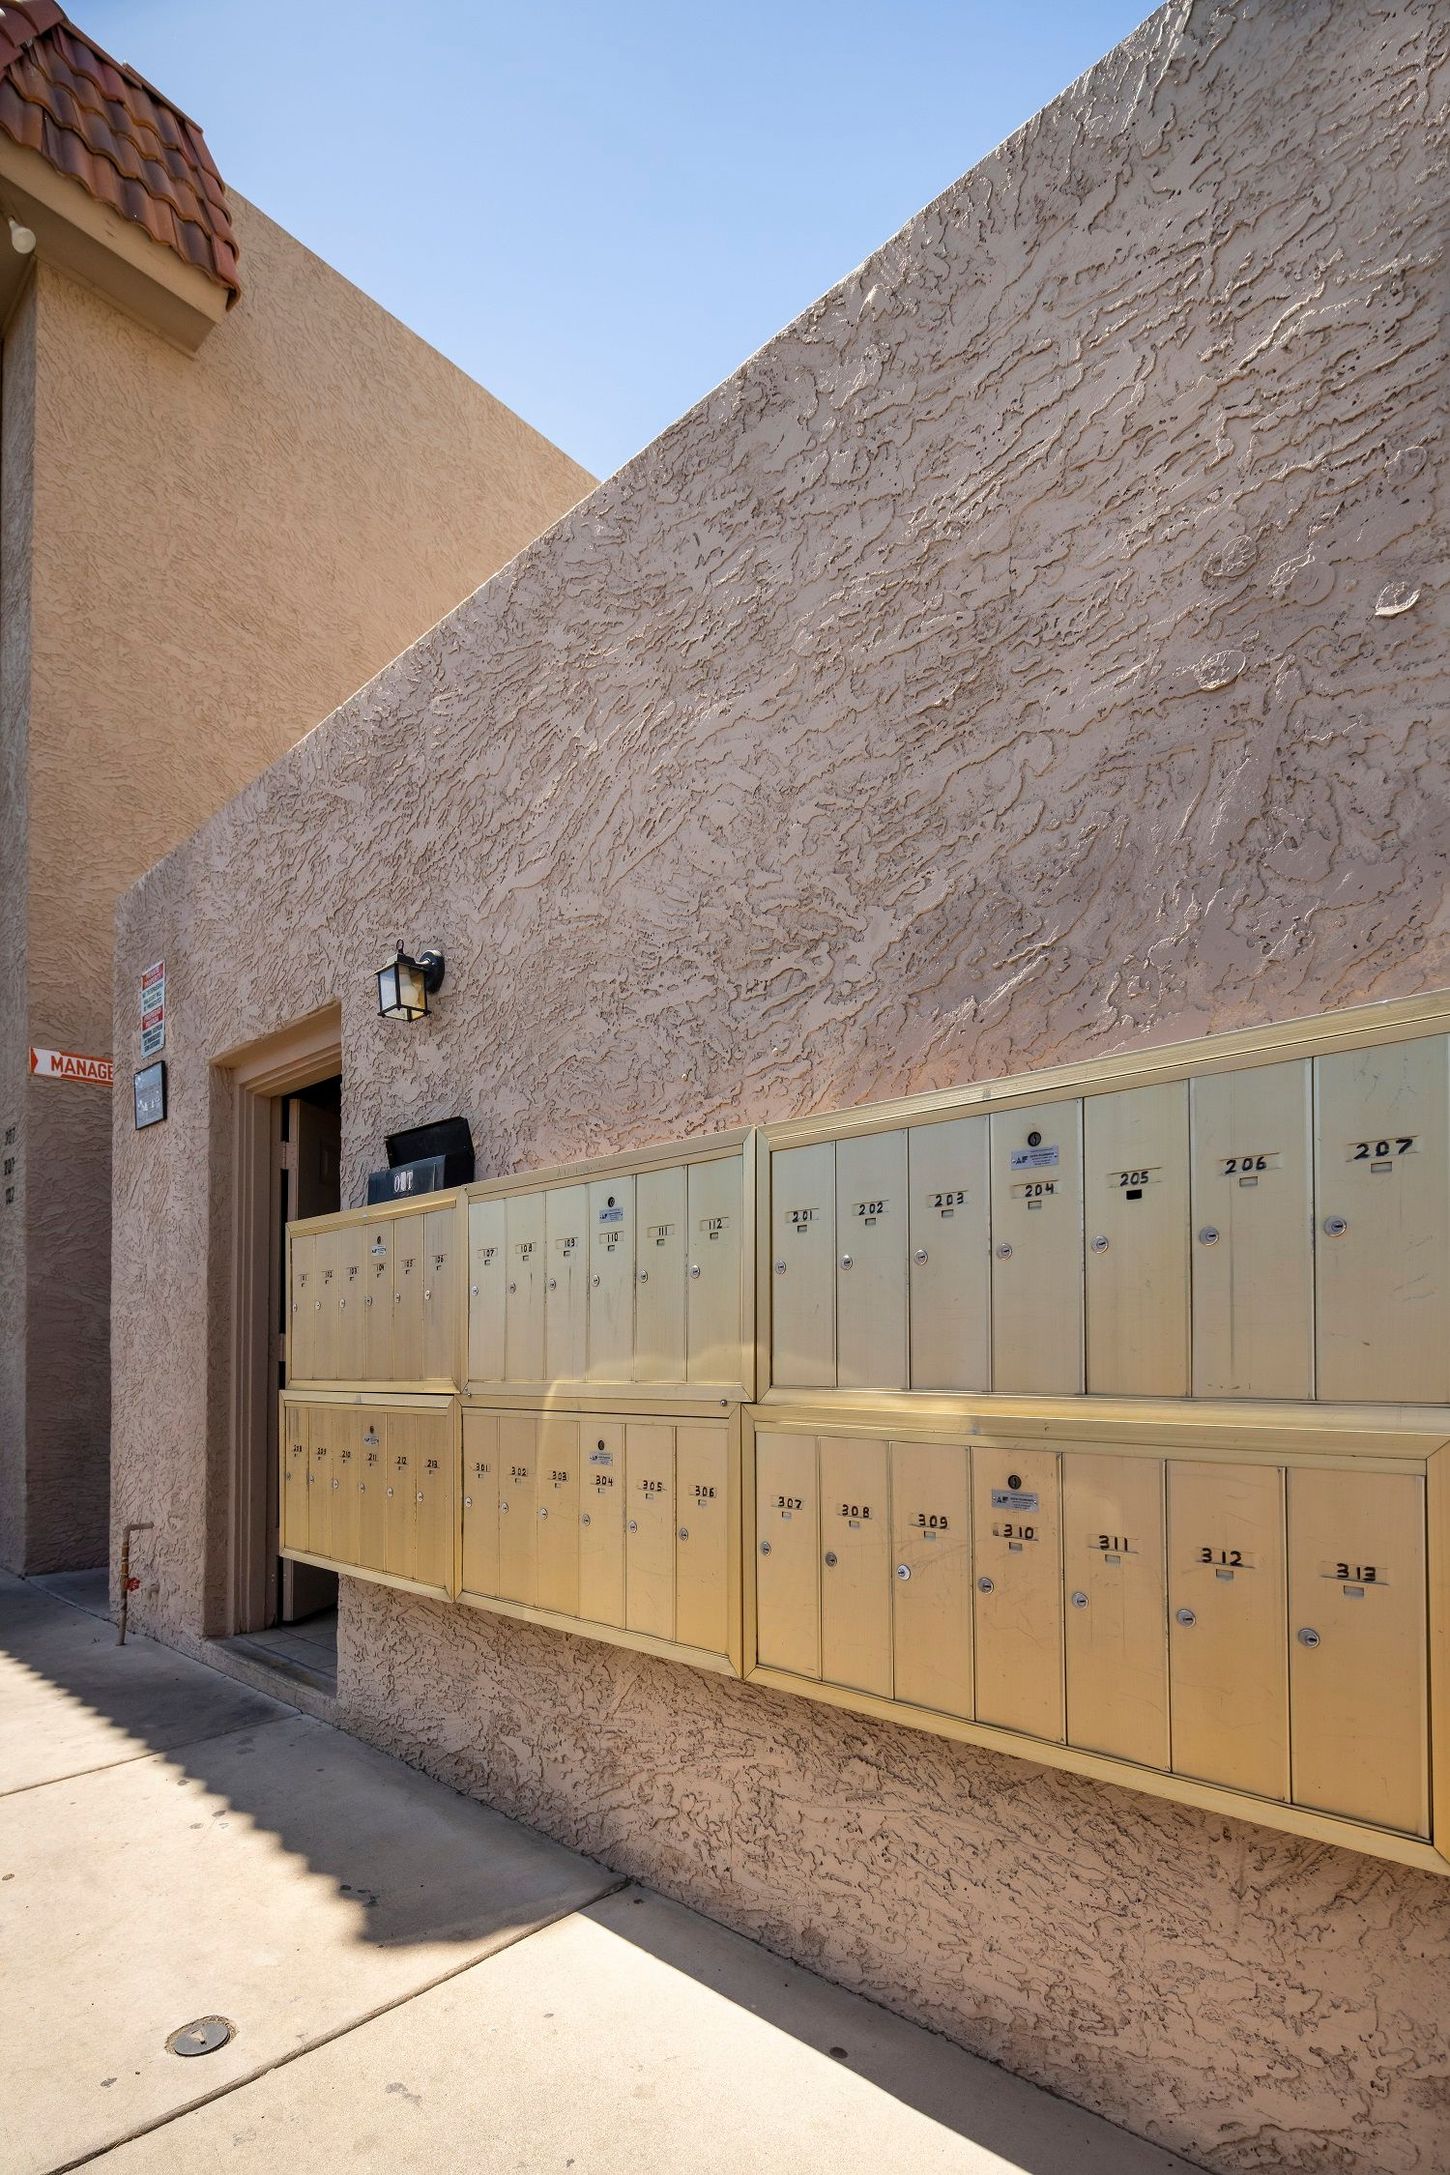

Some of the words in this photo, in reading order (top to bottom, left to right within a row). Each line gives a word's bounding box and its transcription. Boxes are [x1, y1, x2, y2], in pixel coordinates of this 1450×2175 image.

[51, 1056, 113, 1080] MANAGE
[1353, 1138, 1413, 1160] 207
[1224, 1156, 1267, 1175] 206
[1120, 1171, 1149, 1187] 205
[1025, 1183, 1054, 1197] 204
[934, 1192, 964, 1208] 203
[858, 1201, 883, 1215] 202
[792, 1210, 813, 1223] 201
[709, 1218, 722, 1229] 112
[607, 1232, 618, 1242] 110
[658, 1226, 667, 1236] 111
[521, 1243, 532, 1253] 108
[565, 1238, 575, 1247] 109
[483, 1249, 494, 1257] 107
[368, 1453, 377, 1461] 211
[396, 1456, 407, 1465] 212
[427, 1459, 438, 1468] 213
[476, 1462, 488, 1472] 301
[511, 1466, 527, 1476] 302
[552, 1470, 567, 1480] 303
[595, 1475, 613, 1486] 304
[642, 1480, 662, 1491] 305
[695, 1485, 715, 1497] 306
[778, 1496, 802, 1509] 307
[842, 1504, 870, 1518] 308
[918, 1513, 948, 1529] 309
[1003, 1524, 1034, 1539] 310
[1098, 1535, 1128, 1551] 311
[1201, 1547, 1242, 1566] 312
[1336, 1563, 1376, 1581] 313
